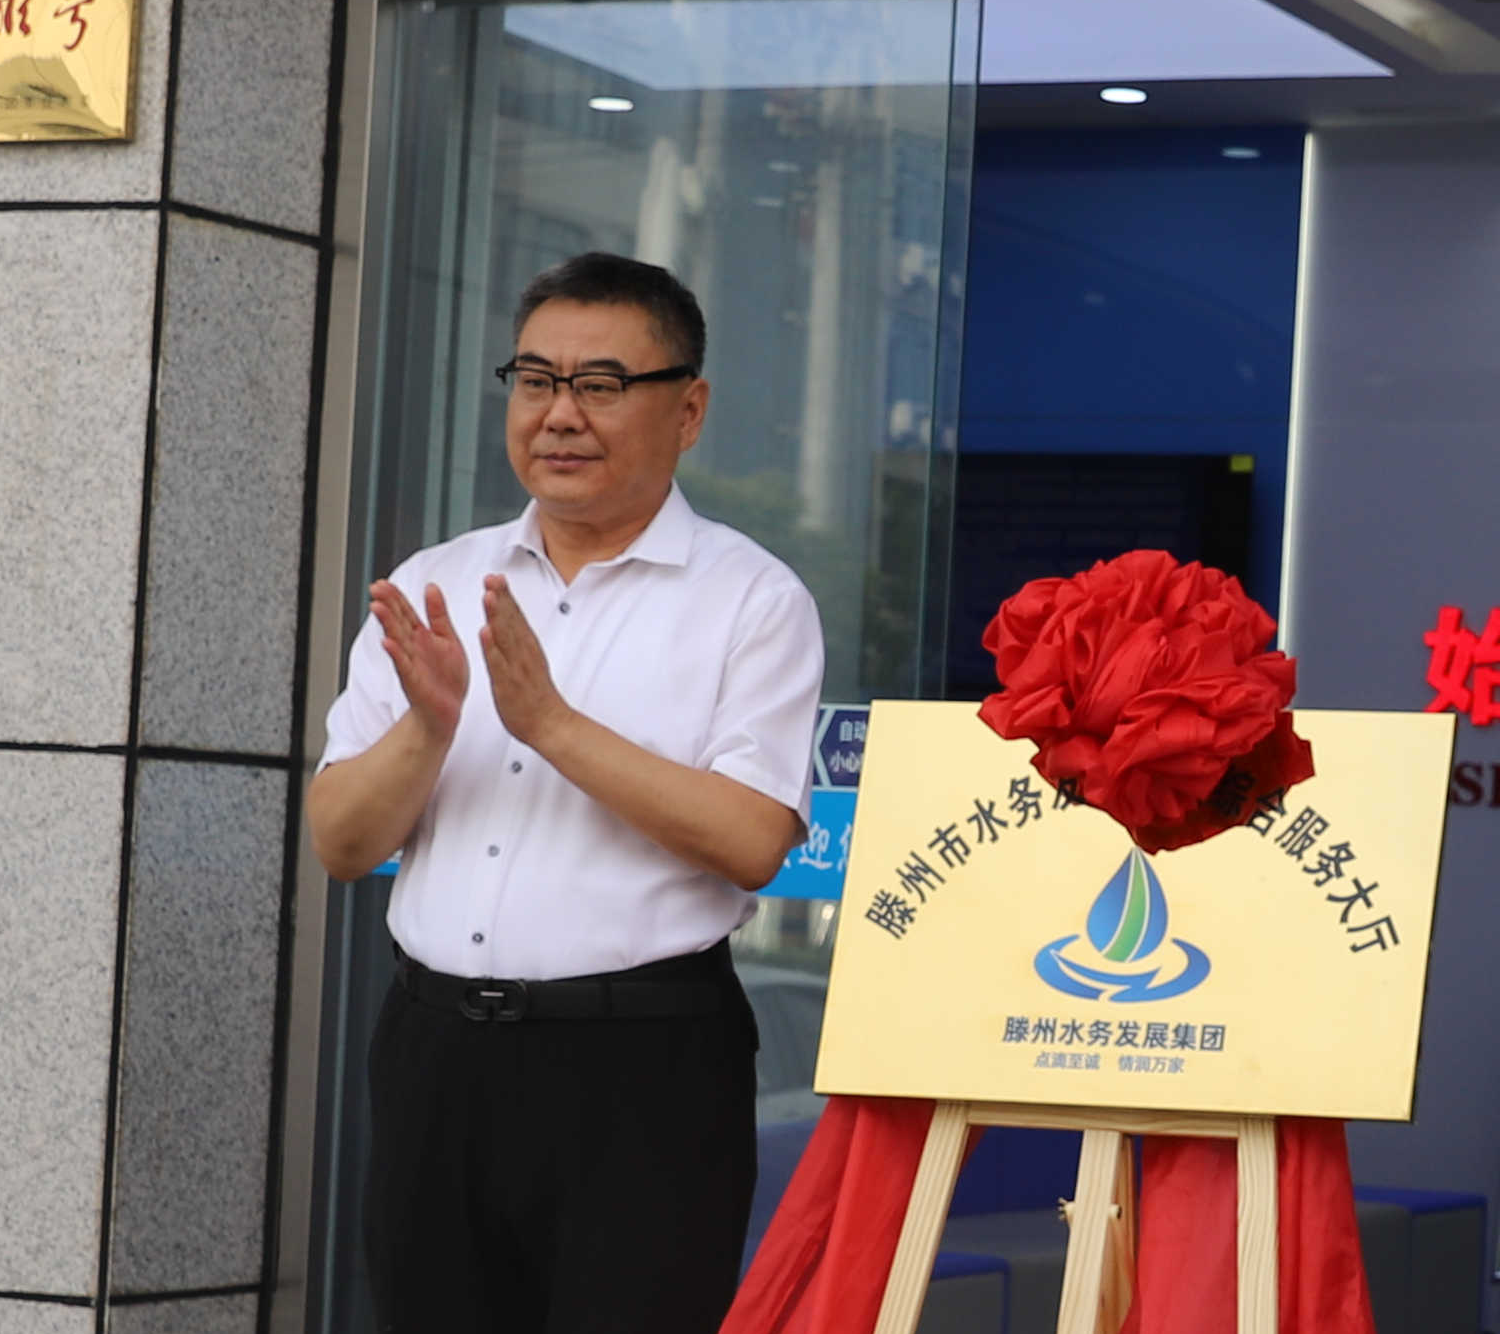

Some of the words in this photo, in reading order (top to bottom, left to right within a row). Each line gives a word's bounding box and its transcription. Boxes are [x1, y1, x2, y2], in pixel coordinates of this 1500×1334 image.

[1001, 1015, 1227, 1053] 滕州水务发展集团
[1034, 1051, 1102, 1071] 点滴至诚
[1117, 1053, 1186, 1075] 情润万家
